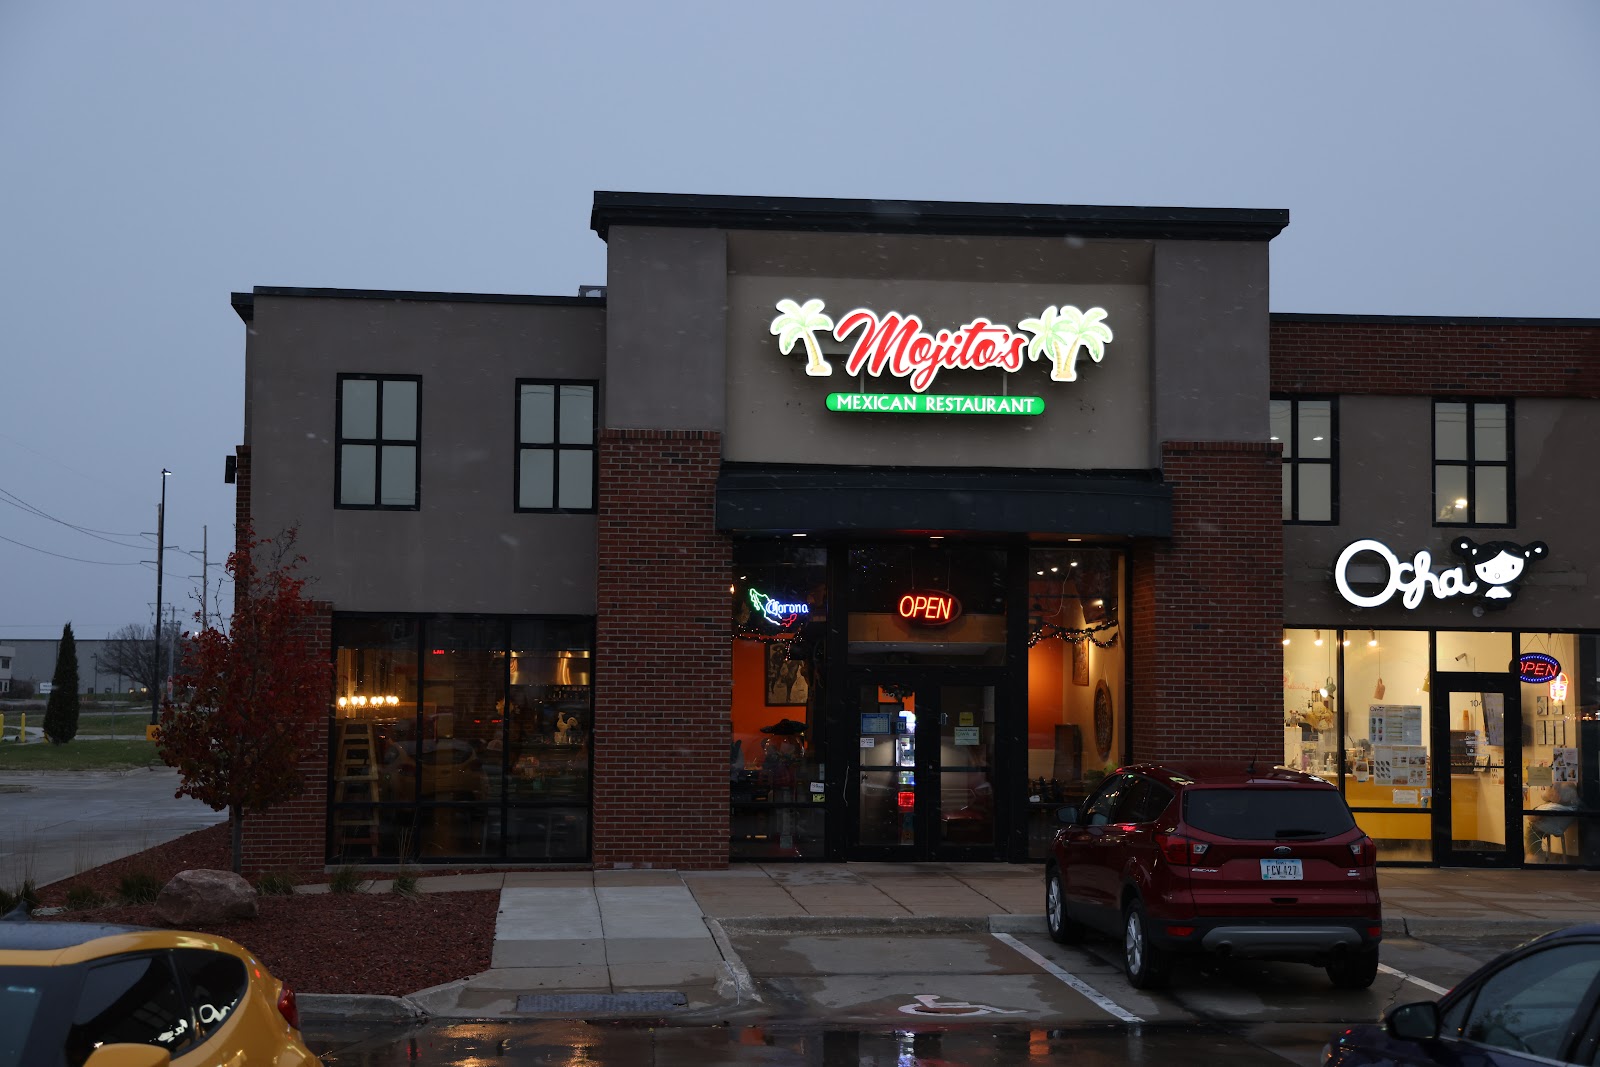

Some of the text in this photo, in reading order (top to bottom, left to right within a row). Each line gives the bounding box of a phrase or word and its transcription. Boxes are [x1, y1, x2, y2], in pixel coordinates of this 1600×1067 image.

[836, 309, 1028, 391] Mojito's
[836, 394, 1035, 413] MEXICAN RESTAURANT
[1334, 539, 1478, 609] Ocha
[766, 599, 809, 616] Corona
[899, 595, 952, 620] OPEN
